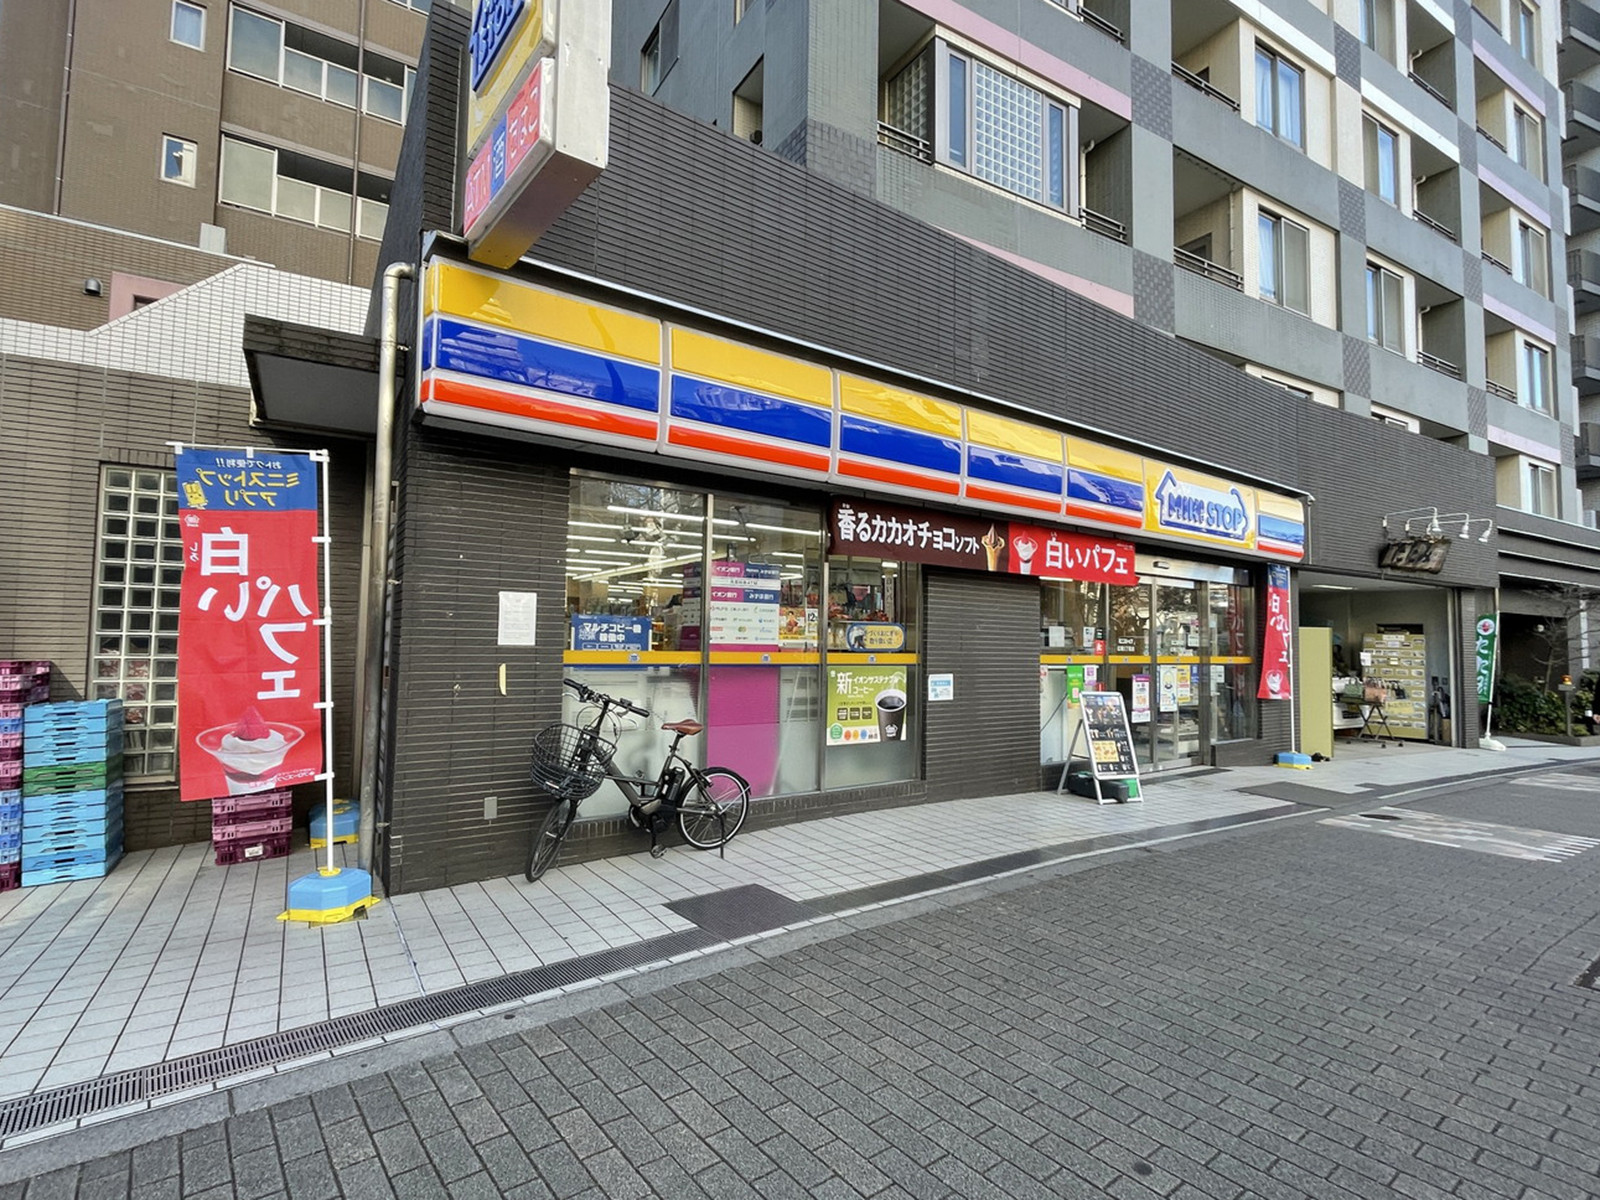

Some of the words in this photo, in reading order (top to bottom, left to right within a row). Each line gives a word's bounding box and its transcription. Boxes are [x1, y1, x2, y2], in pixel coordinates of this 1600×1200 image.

[1206, 501, 1243, 531] STOP
[1045, 537, 1129, 574] 白いパフェ
[836, 672, 853, 695] 新
[853, 686, 875, 694] コーヒー
